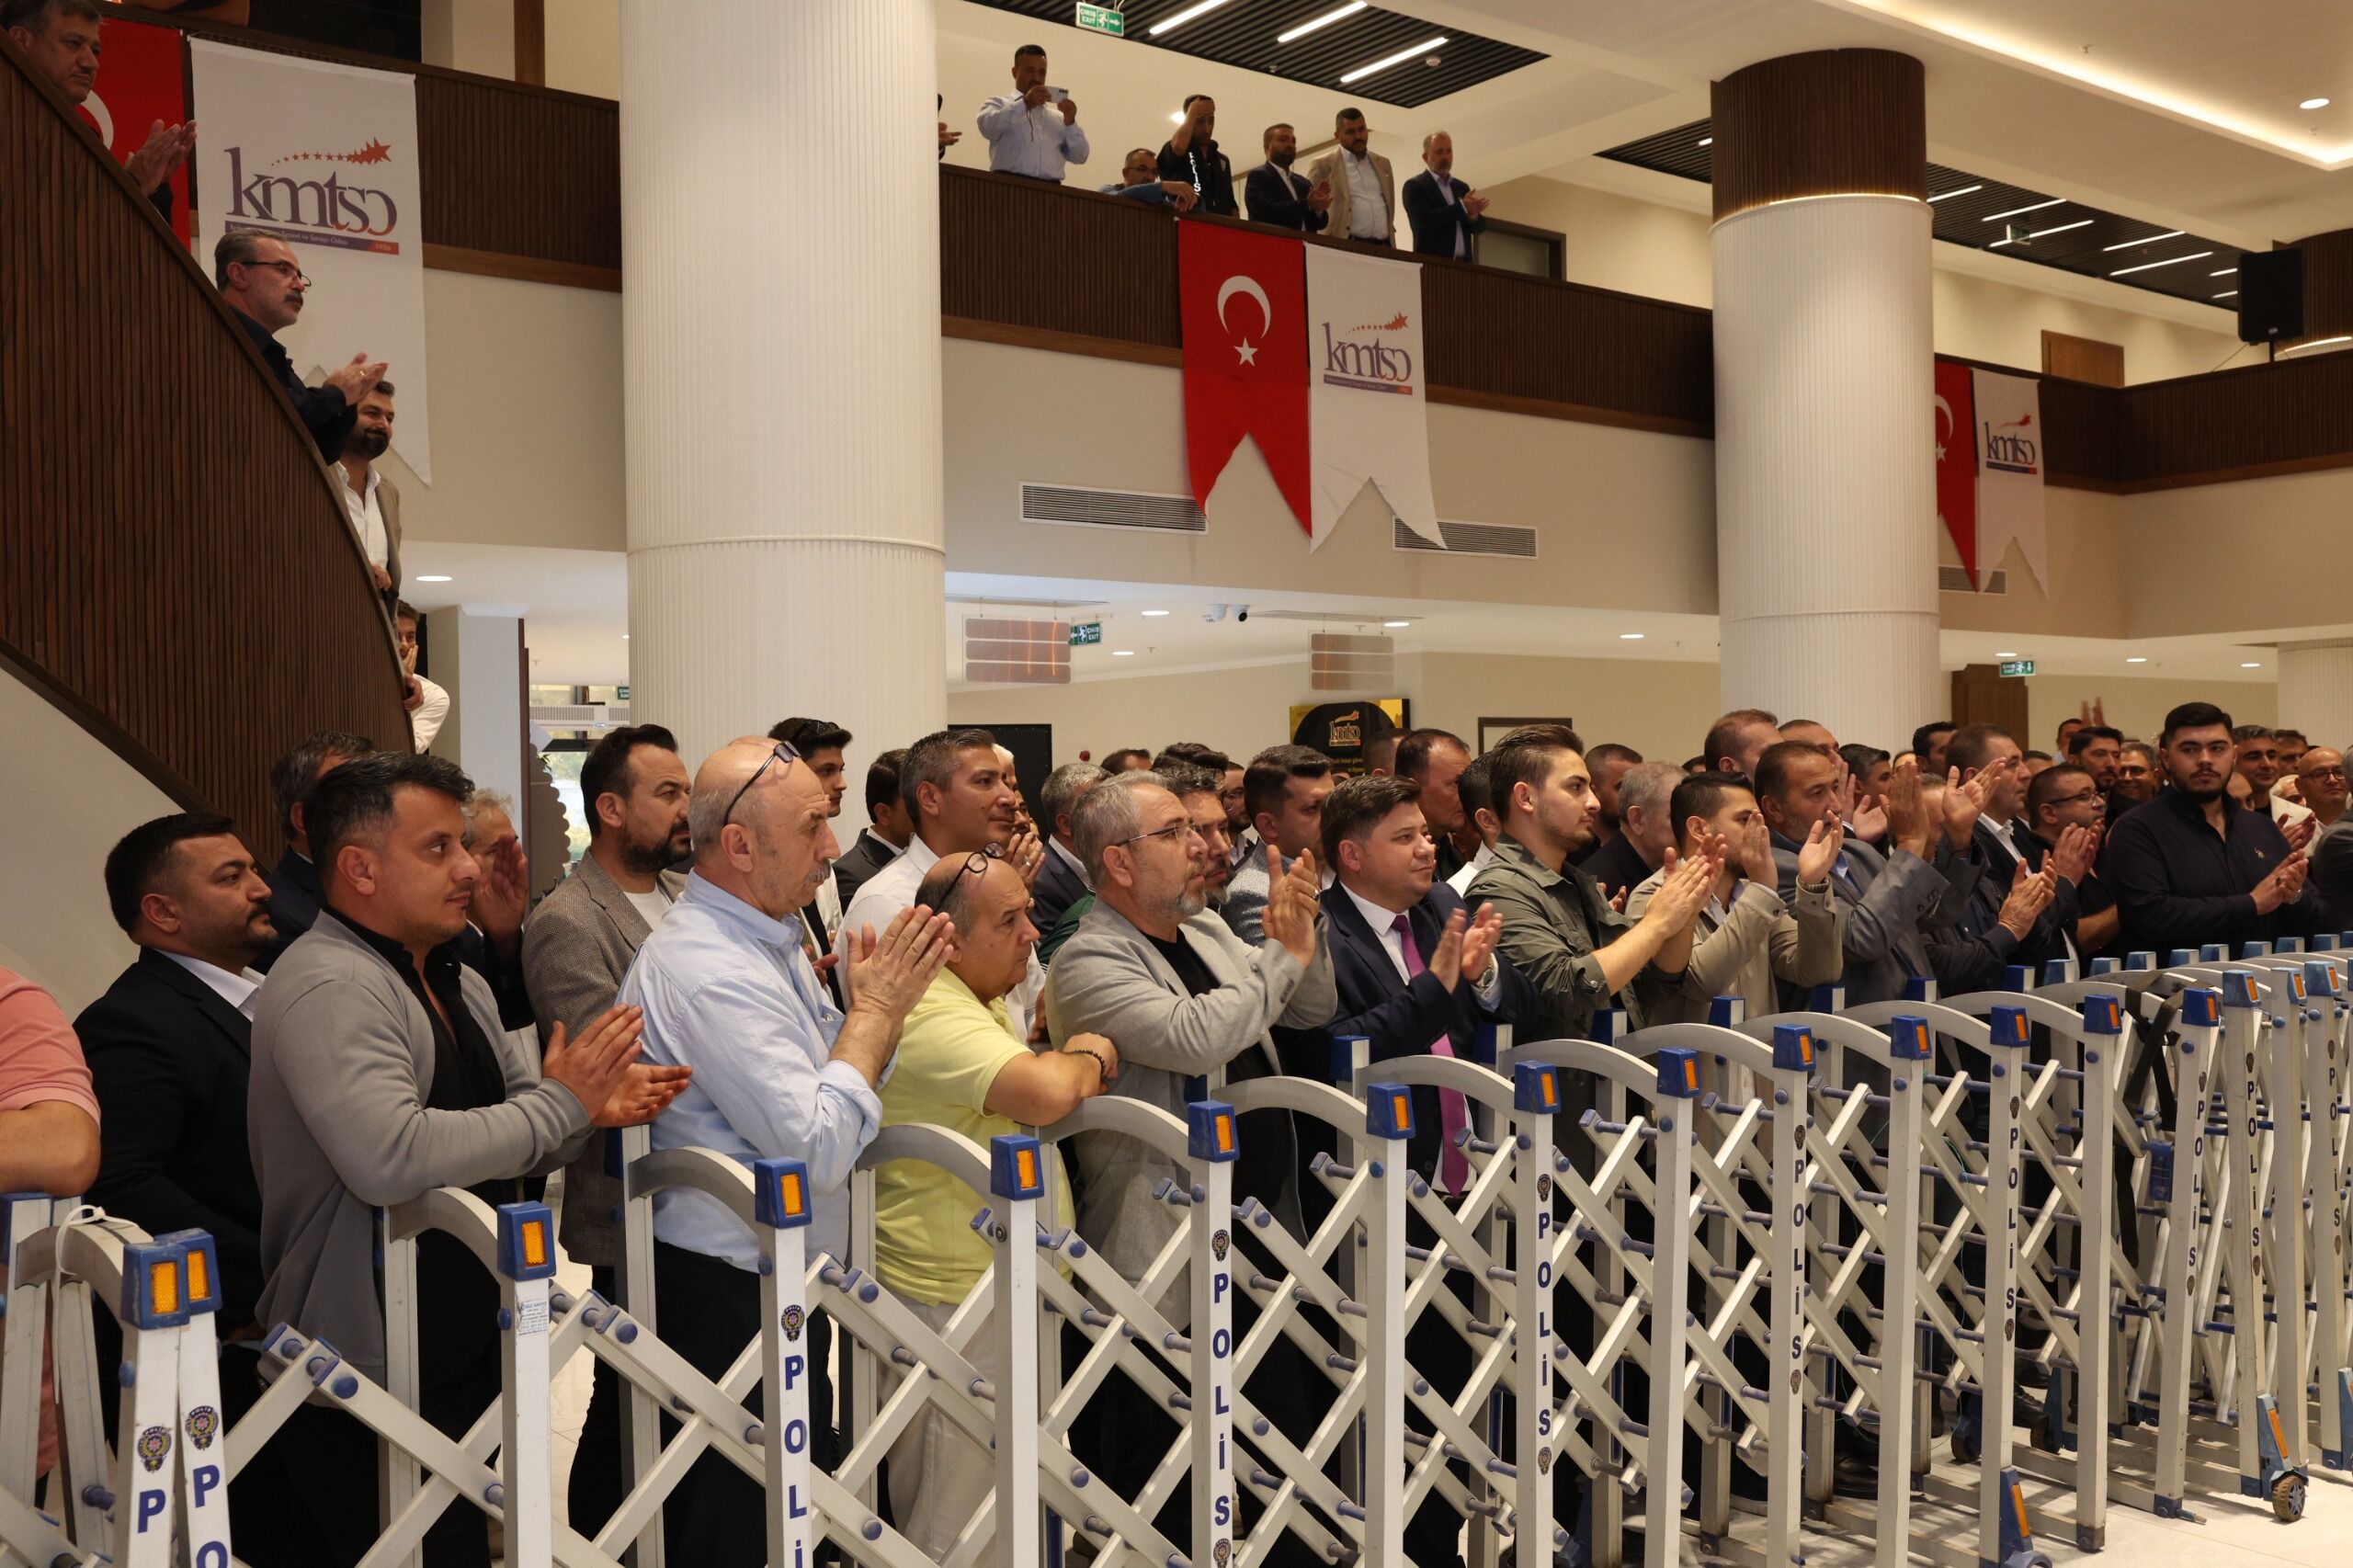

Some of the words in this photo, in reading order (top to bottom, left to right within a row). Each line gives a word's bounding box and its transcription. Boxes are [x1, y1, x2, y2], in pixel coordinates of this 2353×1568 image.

[1537, 1212, 1552, 1437] POLİS
[1791, 1159, 1804, 1359] POLİS
[2006, 1127, 2018, 1310] POLİS
[1212, 1273, 1231, 1527] POLİS
